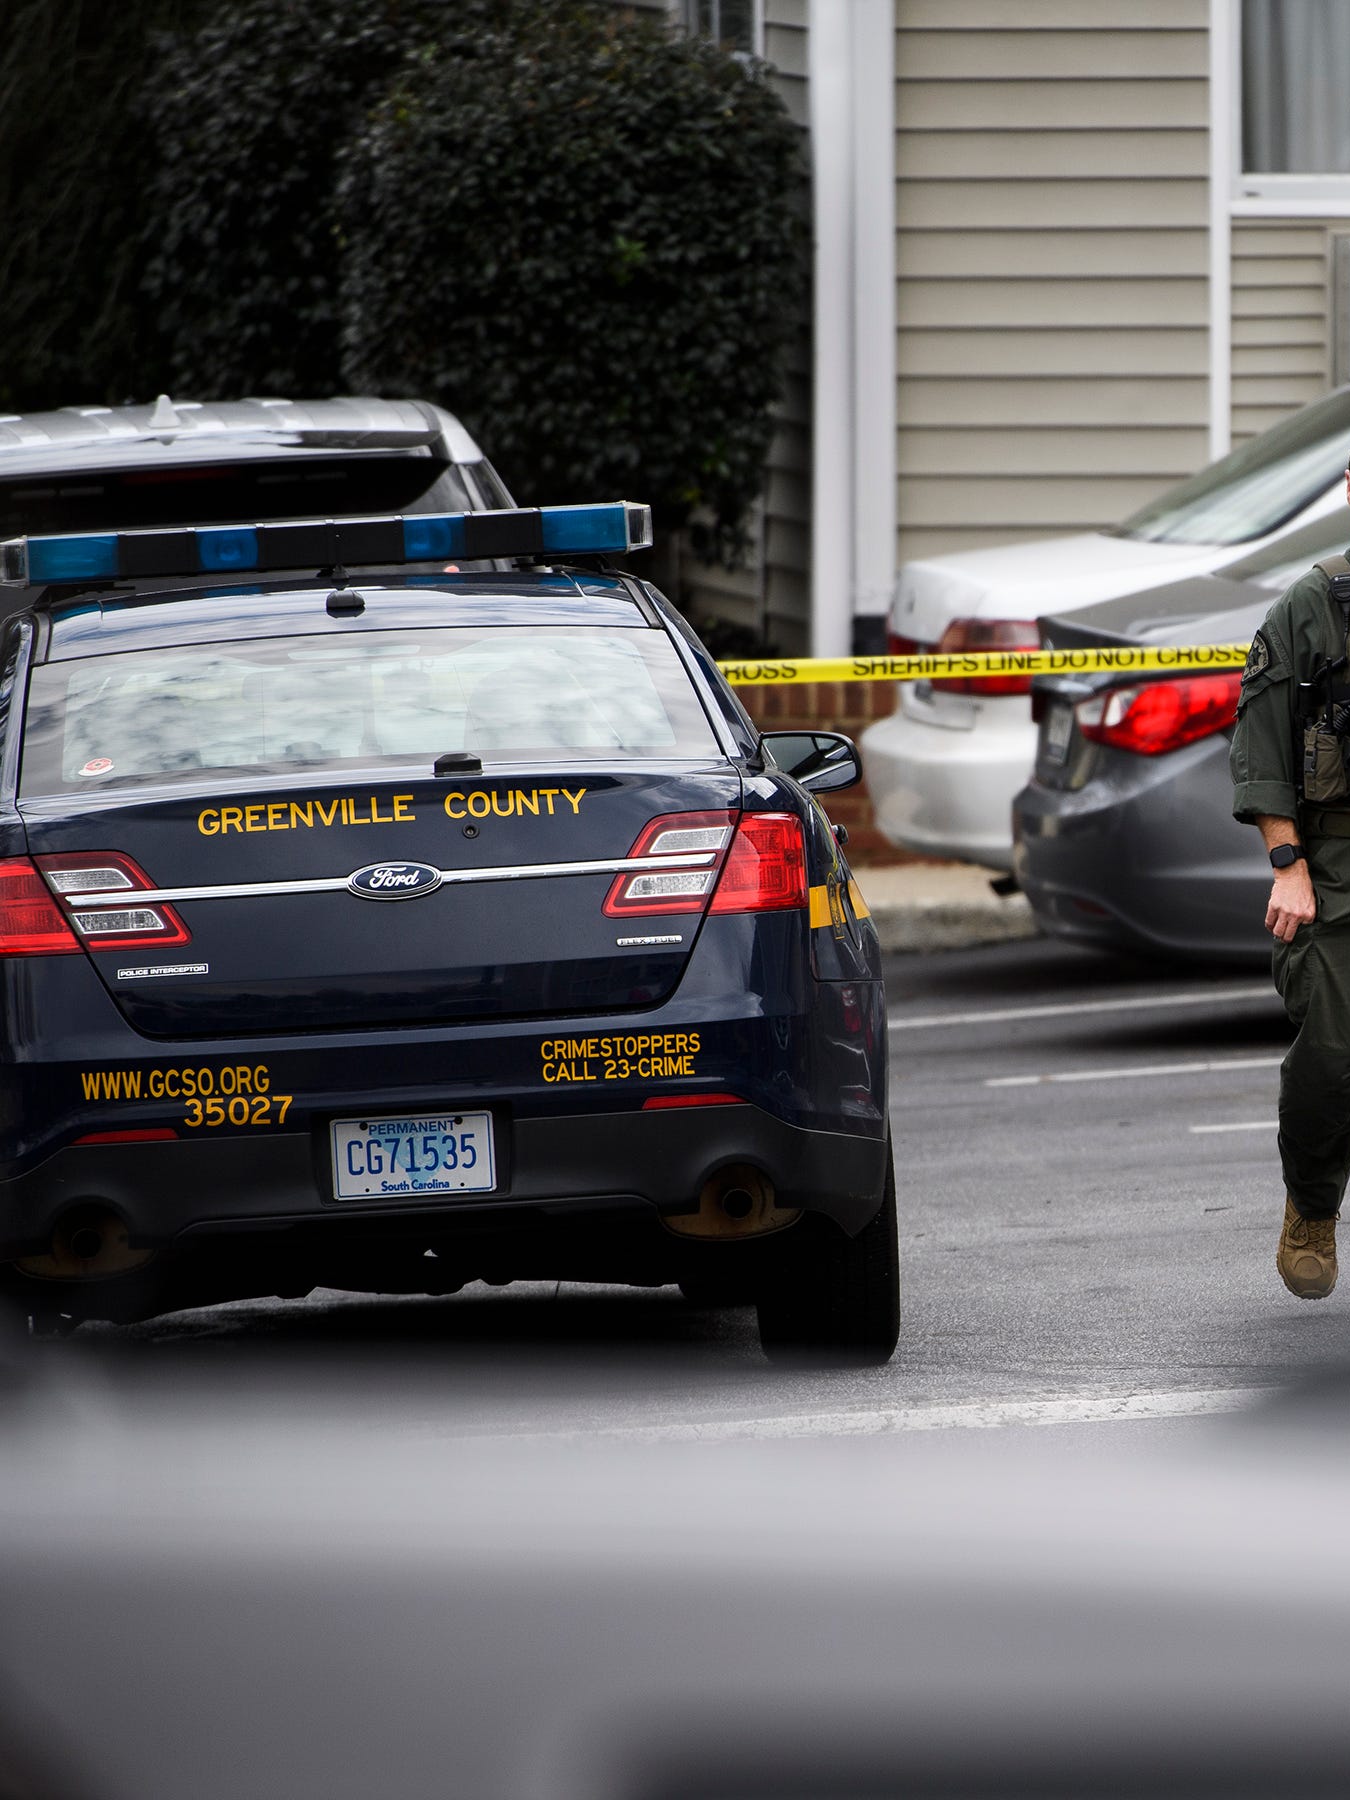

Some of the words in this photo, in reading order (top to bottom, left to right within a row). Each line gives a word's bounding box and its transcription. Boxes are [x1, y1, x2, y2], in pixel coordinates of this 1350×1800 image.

[724, 663, 797, 681] ROSS
[853, 654, 978, 676] SHERIFFS
[985, 652, 1042, 671] LINE
[1050, 650, 1088, 668] DO
[1096, 647, 1148, 666] NOT
[1157, 642, 1248, 665] CROSS
[197, 794, 416, 836] GREENVILLE
[444, 788, 587, 819] COUNTY
[369, 866, 420, 888] Ford
[120, 969, 149, 977] POLICE
[150, 965, 206, 975] INTERCEPTOR
[541, 1033, 700, 1060] CRIMESTOPPERS
[542, 1061, 597, 1082] CALL
[604, 1055, 696, 1079] 23-CRIME
[81, 1065, 270, 1100] WWW.GCSO.ORG
[184, 1095, 293, 1127] 35027
[368, 1120, 456, 1136] PERMANENT
[347, 1133, 477, 1176] CG71535
[381, 1181, 410, 1192] South
[411, 1179, 450, 1190] Carolina
